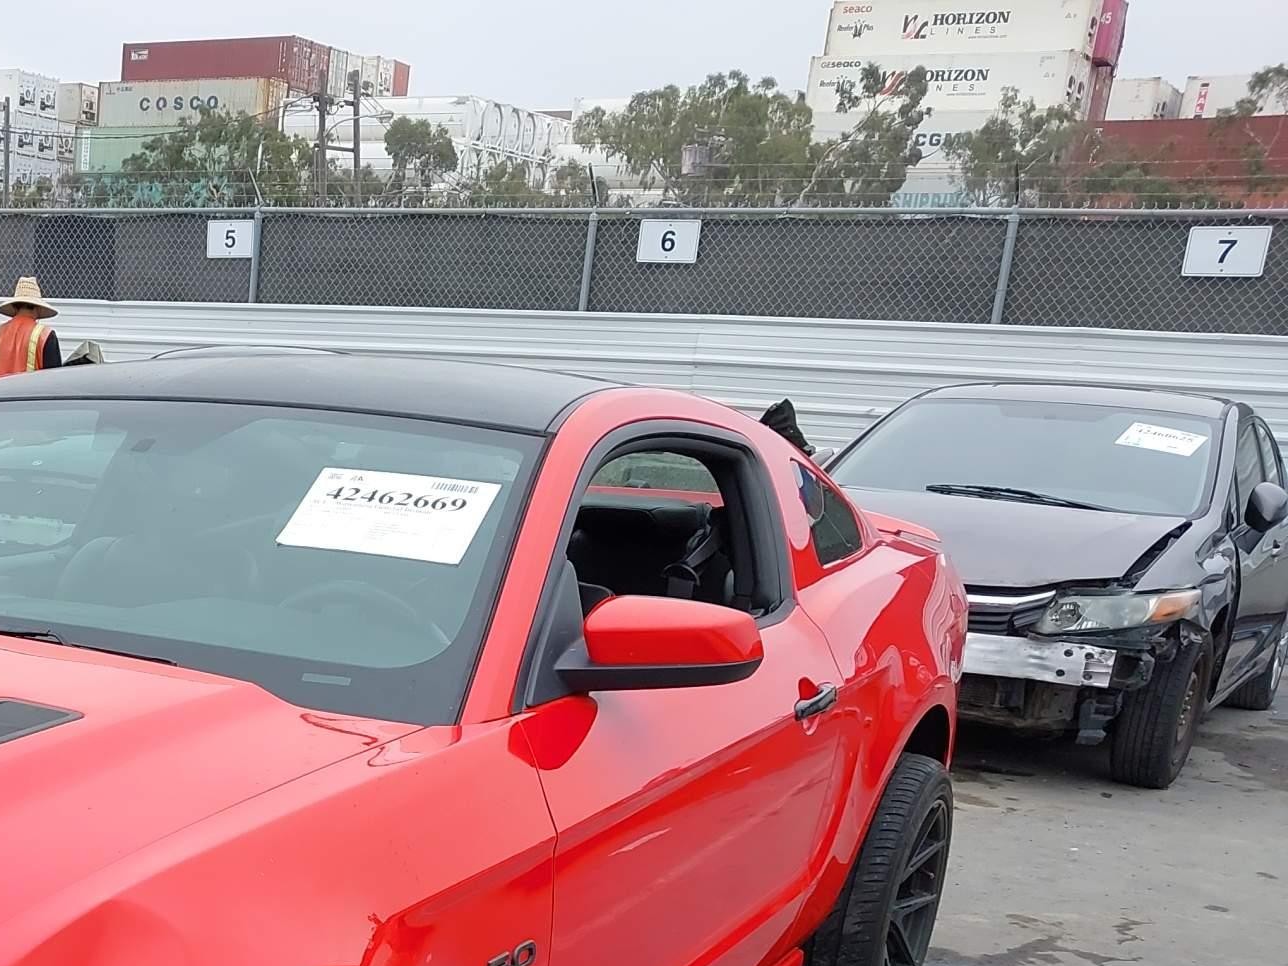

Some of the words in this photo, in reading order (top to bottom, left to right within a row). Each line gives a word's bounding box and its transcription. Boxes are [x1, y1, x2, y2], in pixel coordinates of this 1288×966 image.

[843, 5, 873, 14] seaco
[931, 11, 1011, 27] HORIZON
[930, 26, 997, 36] LINES
[925, 68, 990, 82] ORIZON
[139, 95, 219, 112] COSCO
[224, 229, 236, 248] 5
[661, 230, 676, 252] 6
[1218, 239, 1238, 264] 7
[326, 485, 468, 512] 42462669
